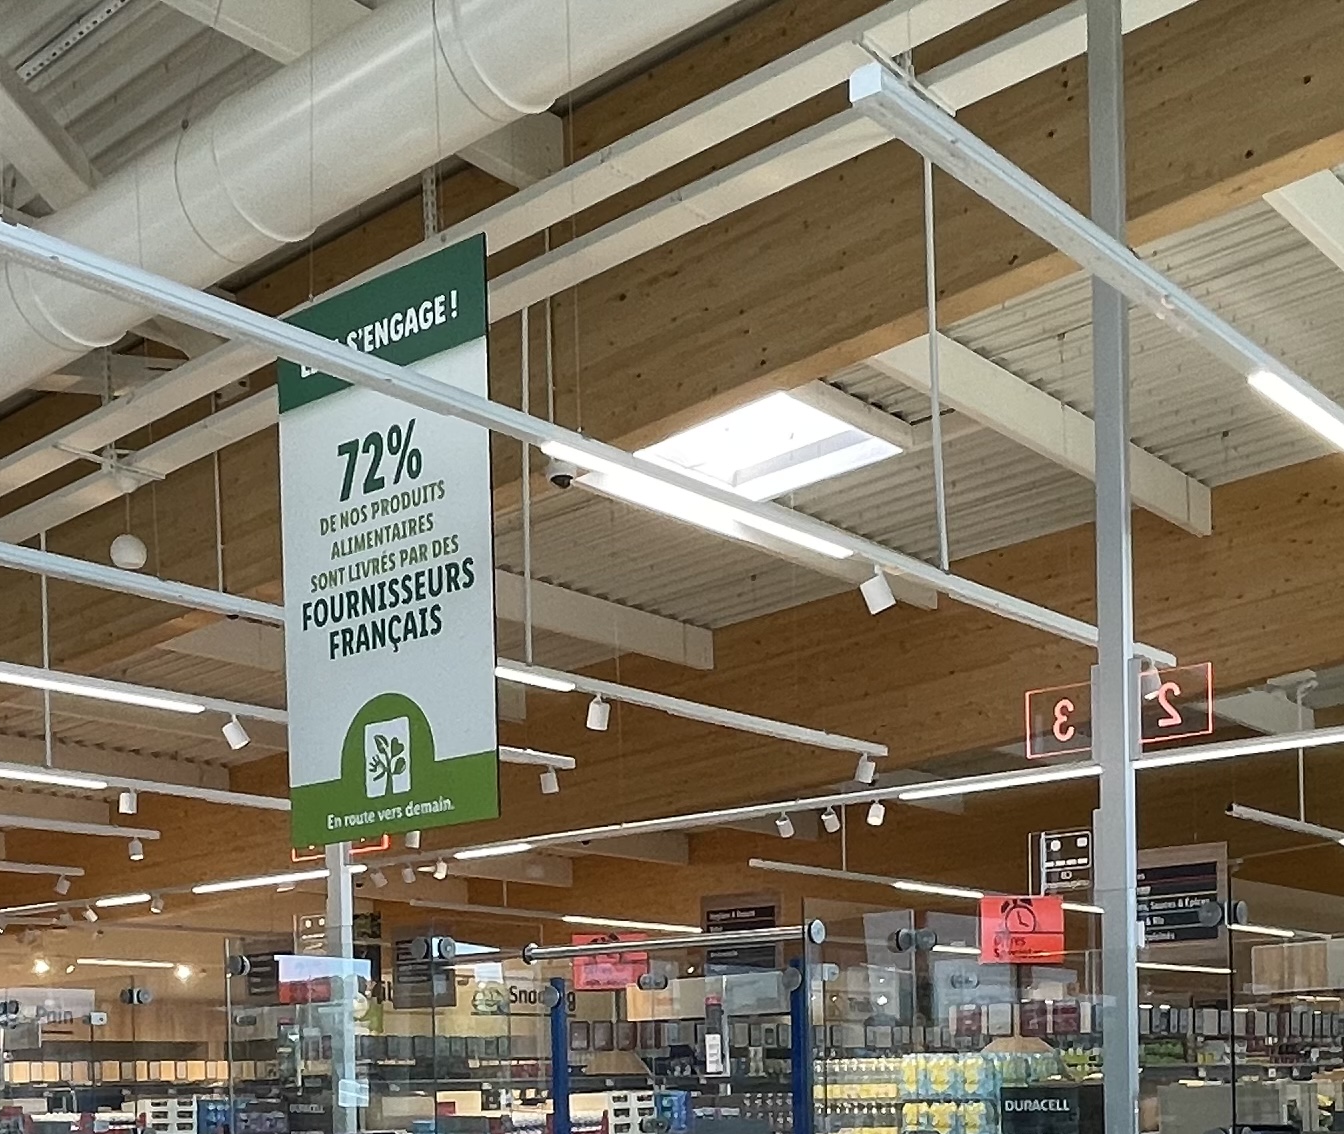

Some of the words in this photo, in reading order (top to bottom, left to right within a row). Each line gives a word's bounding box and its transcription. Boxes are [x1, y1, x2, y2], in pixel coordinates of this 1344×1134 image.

[337, 418, 422, 502] 72%
[319, 514, 337, 536] DE
[339, 504, 368, 528] NOS
[371, 480, 446, 519] PRODUITS
[330, 512, 435, 560] ALIMENTAIRES
[311, 567, 346, 593] SONT
[348, 550, 396, 583] LIVRÉS
[400, 546, 429, 568] PAR
[432, 535, 459, 559] DES
[302, 557, 475, 631] FOURNISSEURS
[329, 604, 443, 660] FRANÇAIS
[327, 813, 343, 830] En
[344, 810, 375, 828] route
[377, 805, 403, 822] vers
[1005, 1099, 1071, 1112] DURACELL
